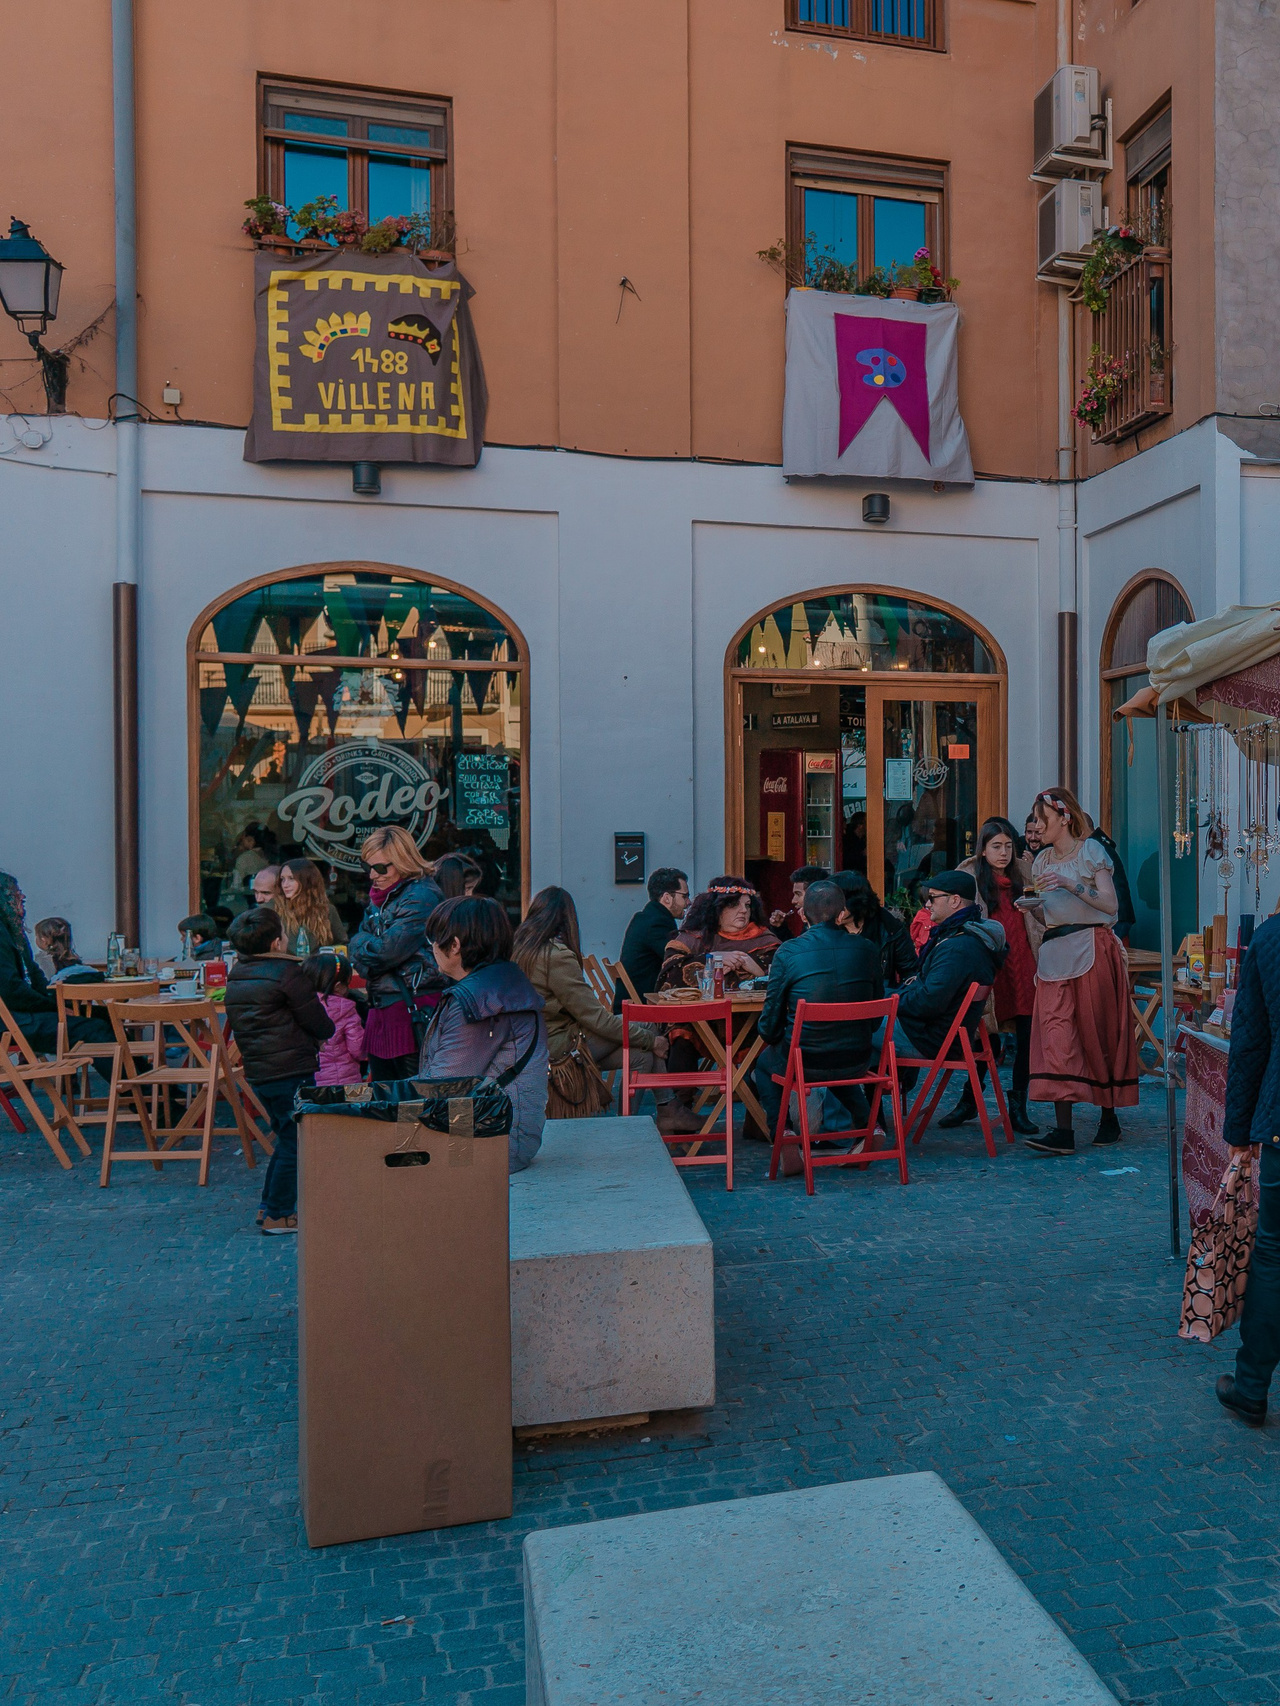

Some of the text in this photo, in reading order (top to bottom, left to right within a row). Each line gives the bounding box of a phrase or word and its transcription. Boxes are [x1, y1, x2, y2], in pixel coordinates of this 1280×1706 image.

[351, 347, 409, 374] 1488
[772, 715, 811, 725] LA ATALAYA
[847, 716, 866, 727] TOIL
[313, 749, 421, 783] FOOD DRINKS GRILL FRIENDS
[912, 764, 950, 782] Rodeo
[277, 772, 450, 842] Rodeo
[355, 826, 379, 834] DINE
[327, 845, 363, 864] VILLENA
